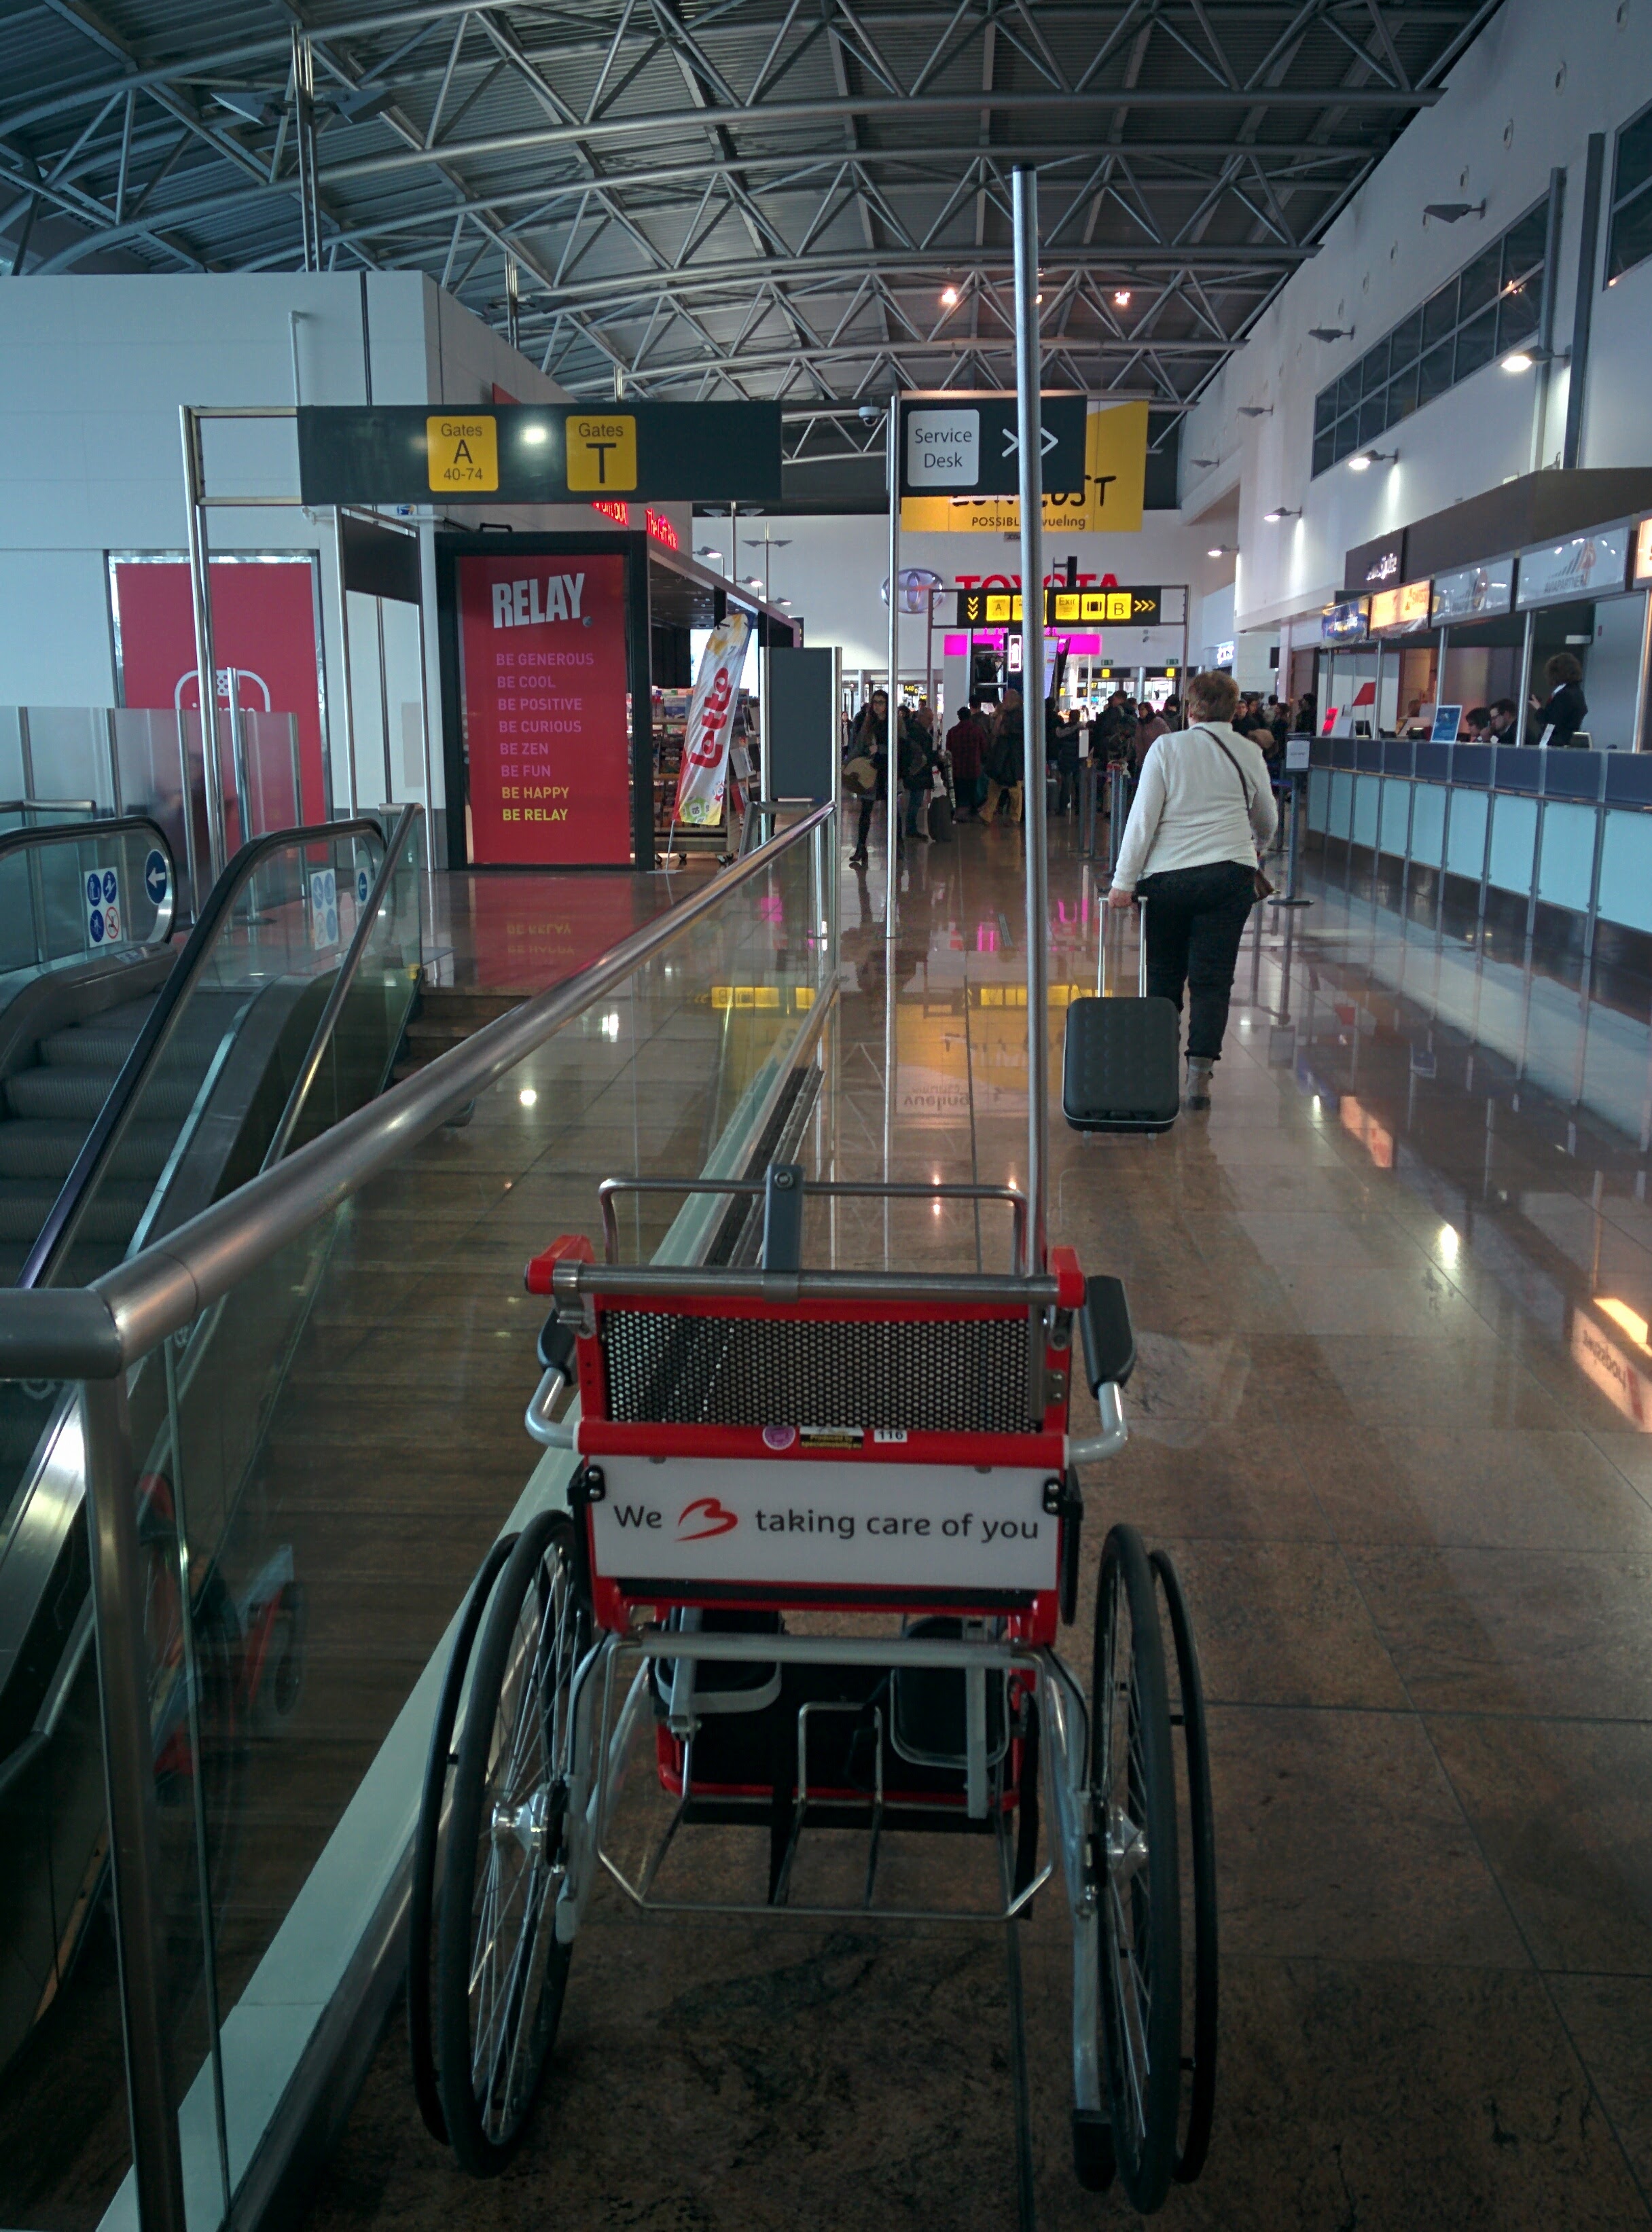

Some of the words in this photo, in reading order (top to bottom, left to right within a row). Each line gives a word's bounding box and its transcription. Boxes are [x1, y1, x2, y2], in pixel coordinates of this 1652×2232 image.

[441, 422, 483, 437] Gates
[578, 422, 624, 437] Gates
[914, 428, 972, 444] Service
[453, 439, 473, 464] A
[586, 443, 617, 484] T
[924, 452, 963, 468] Desk
[443, 467, 484, 481] 40-74
[971, 516, 1020, 526] POSSIBL
[492, 572, 585, 629] RELAY
[1114, 602, 1124, 616] B
[497, 653, 515, 666] BE
[518, 653, 594, 666] GENEROUS
[497, 676, 516, 688] BE
[518, 675, 556, 688] COOL
[498, 698, 517, 710] BE
[520, 698, 582, 710] POSITIVE
[690, 667, 732, 768] Lotto
[499, 721, 518, 733] BE
[521, 720, 582, 733] CURIOUS
[500, 743, 518, 755] BE
[522, 742, 549, 755] ZEN
[501, 766, 519, 777] BE
[522, 765, 551, 777] FUN
[501, 787, 520, 799] BE
[524, 787, 569, 799] HAPPY
[503, 809, 521, 821] BE
[524, 808, 569, 821] RELAY
[879, 1430, 904, 1441] 116
[614, 1505, 662, 1530] We
[756, 1509, 855, 1540] taking
[867, 1517, 931, 1536] care
[942, 1513, 974, 1537] of
[982, 1522, 1039, 1544] you
